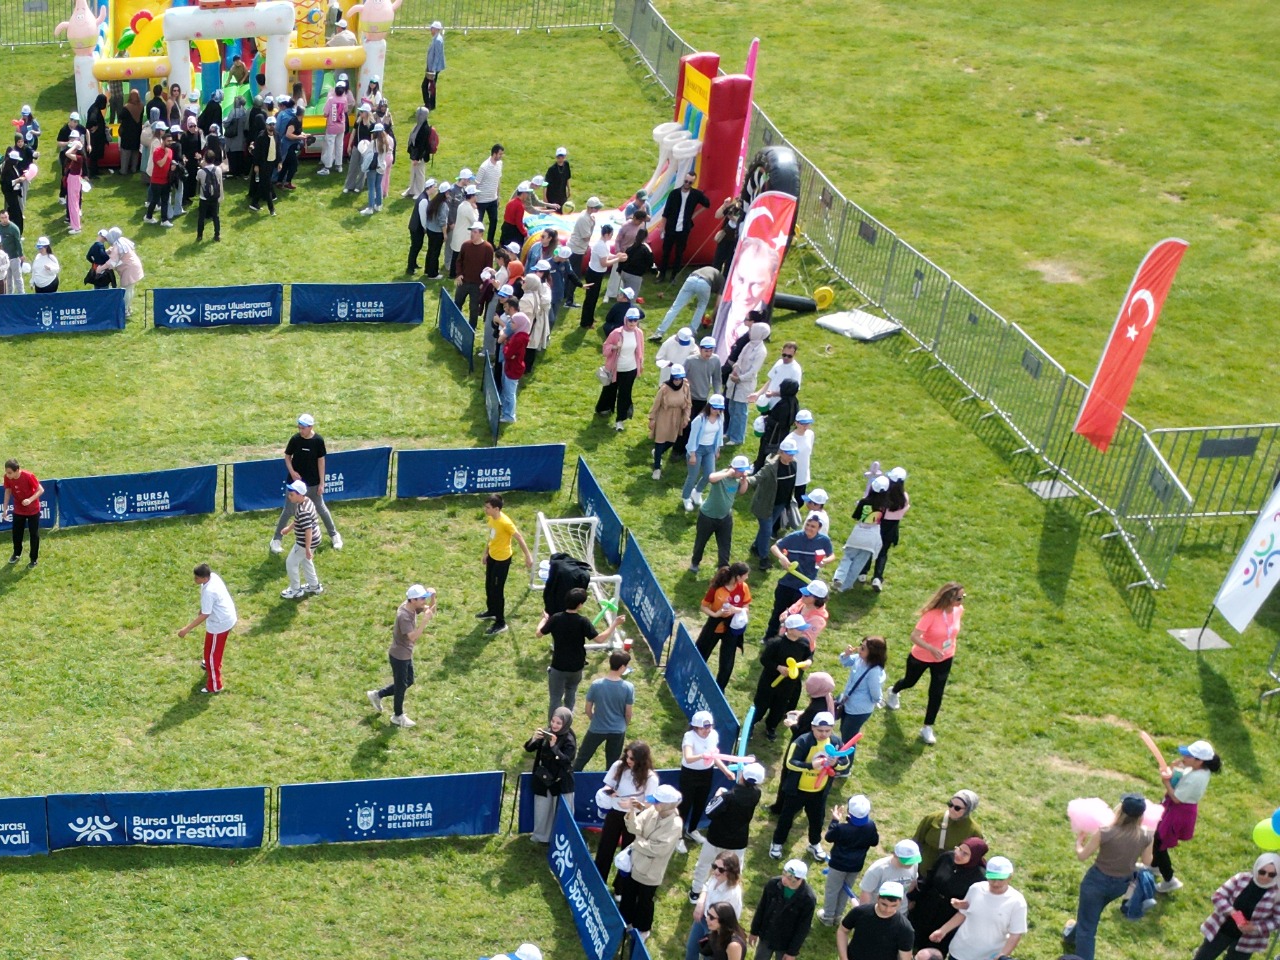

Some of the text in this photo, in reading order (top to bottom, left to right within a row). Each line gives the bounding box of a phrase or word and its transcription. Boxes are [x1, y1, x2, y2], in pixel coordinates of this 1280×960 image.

[204, 308, 273, 322] Spor Festivali
[325, 473, 344, 481] RSA
[477, 467, 512, 476] BURSA
[136, 491, 170, 501] BURSA
[387, 802, 433, 814] BURSA
[132, 813, 243, 826] Bursa Uluslararası
[132, 823, 247, 843] Spor Festivali
[568, 880, 587, 912] Spor
